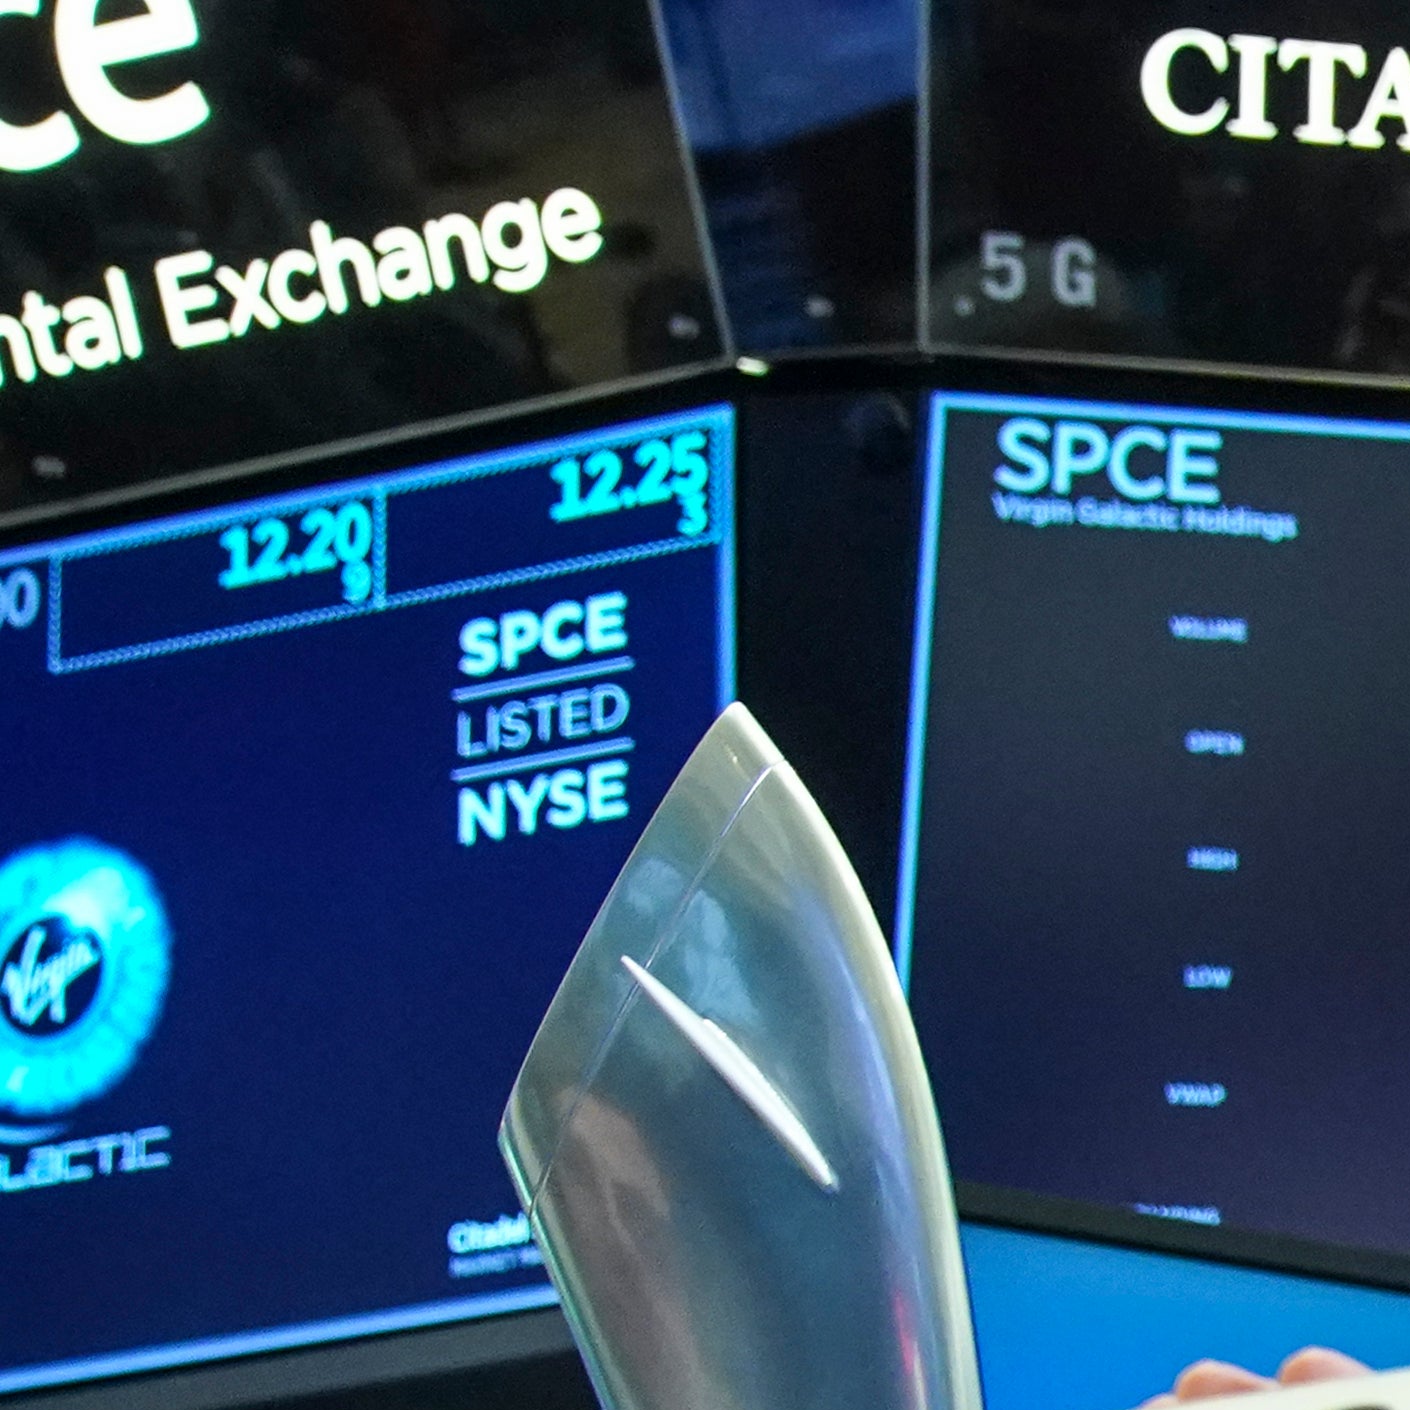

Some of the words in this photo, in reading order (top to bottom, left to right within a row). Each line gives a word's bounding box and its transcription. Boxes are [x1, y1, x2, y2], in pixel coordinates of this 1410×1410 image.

[155, 187, 603, 348] Exchange
[549, 433, 708, 522] 12.25
[994, 417, 1223, 503] SPCE
[218, 502, 372, 588] 12.20
[992, 491, 1075, 527] Virgin
[458, 594, 628, 676] SPCE
[457, 684, 630, 757] LISTED
[457, 759, 629, 845] NYSE
